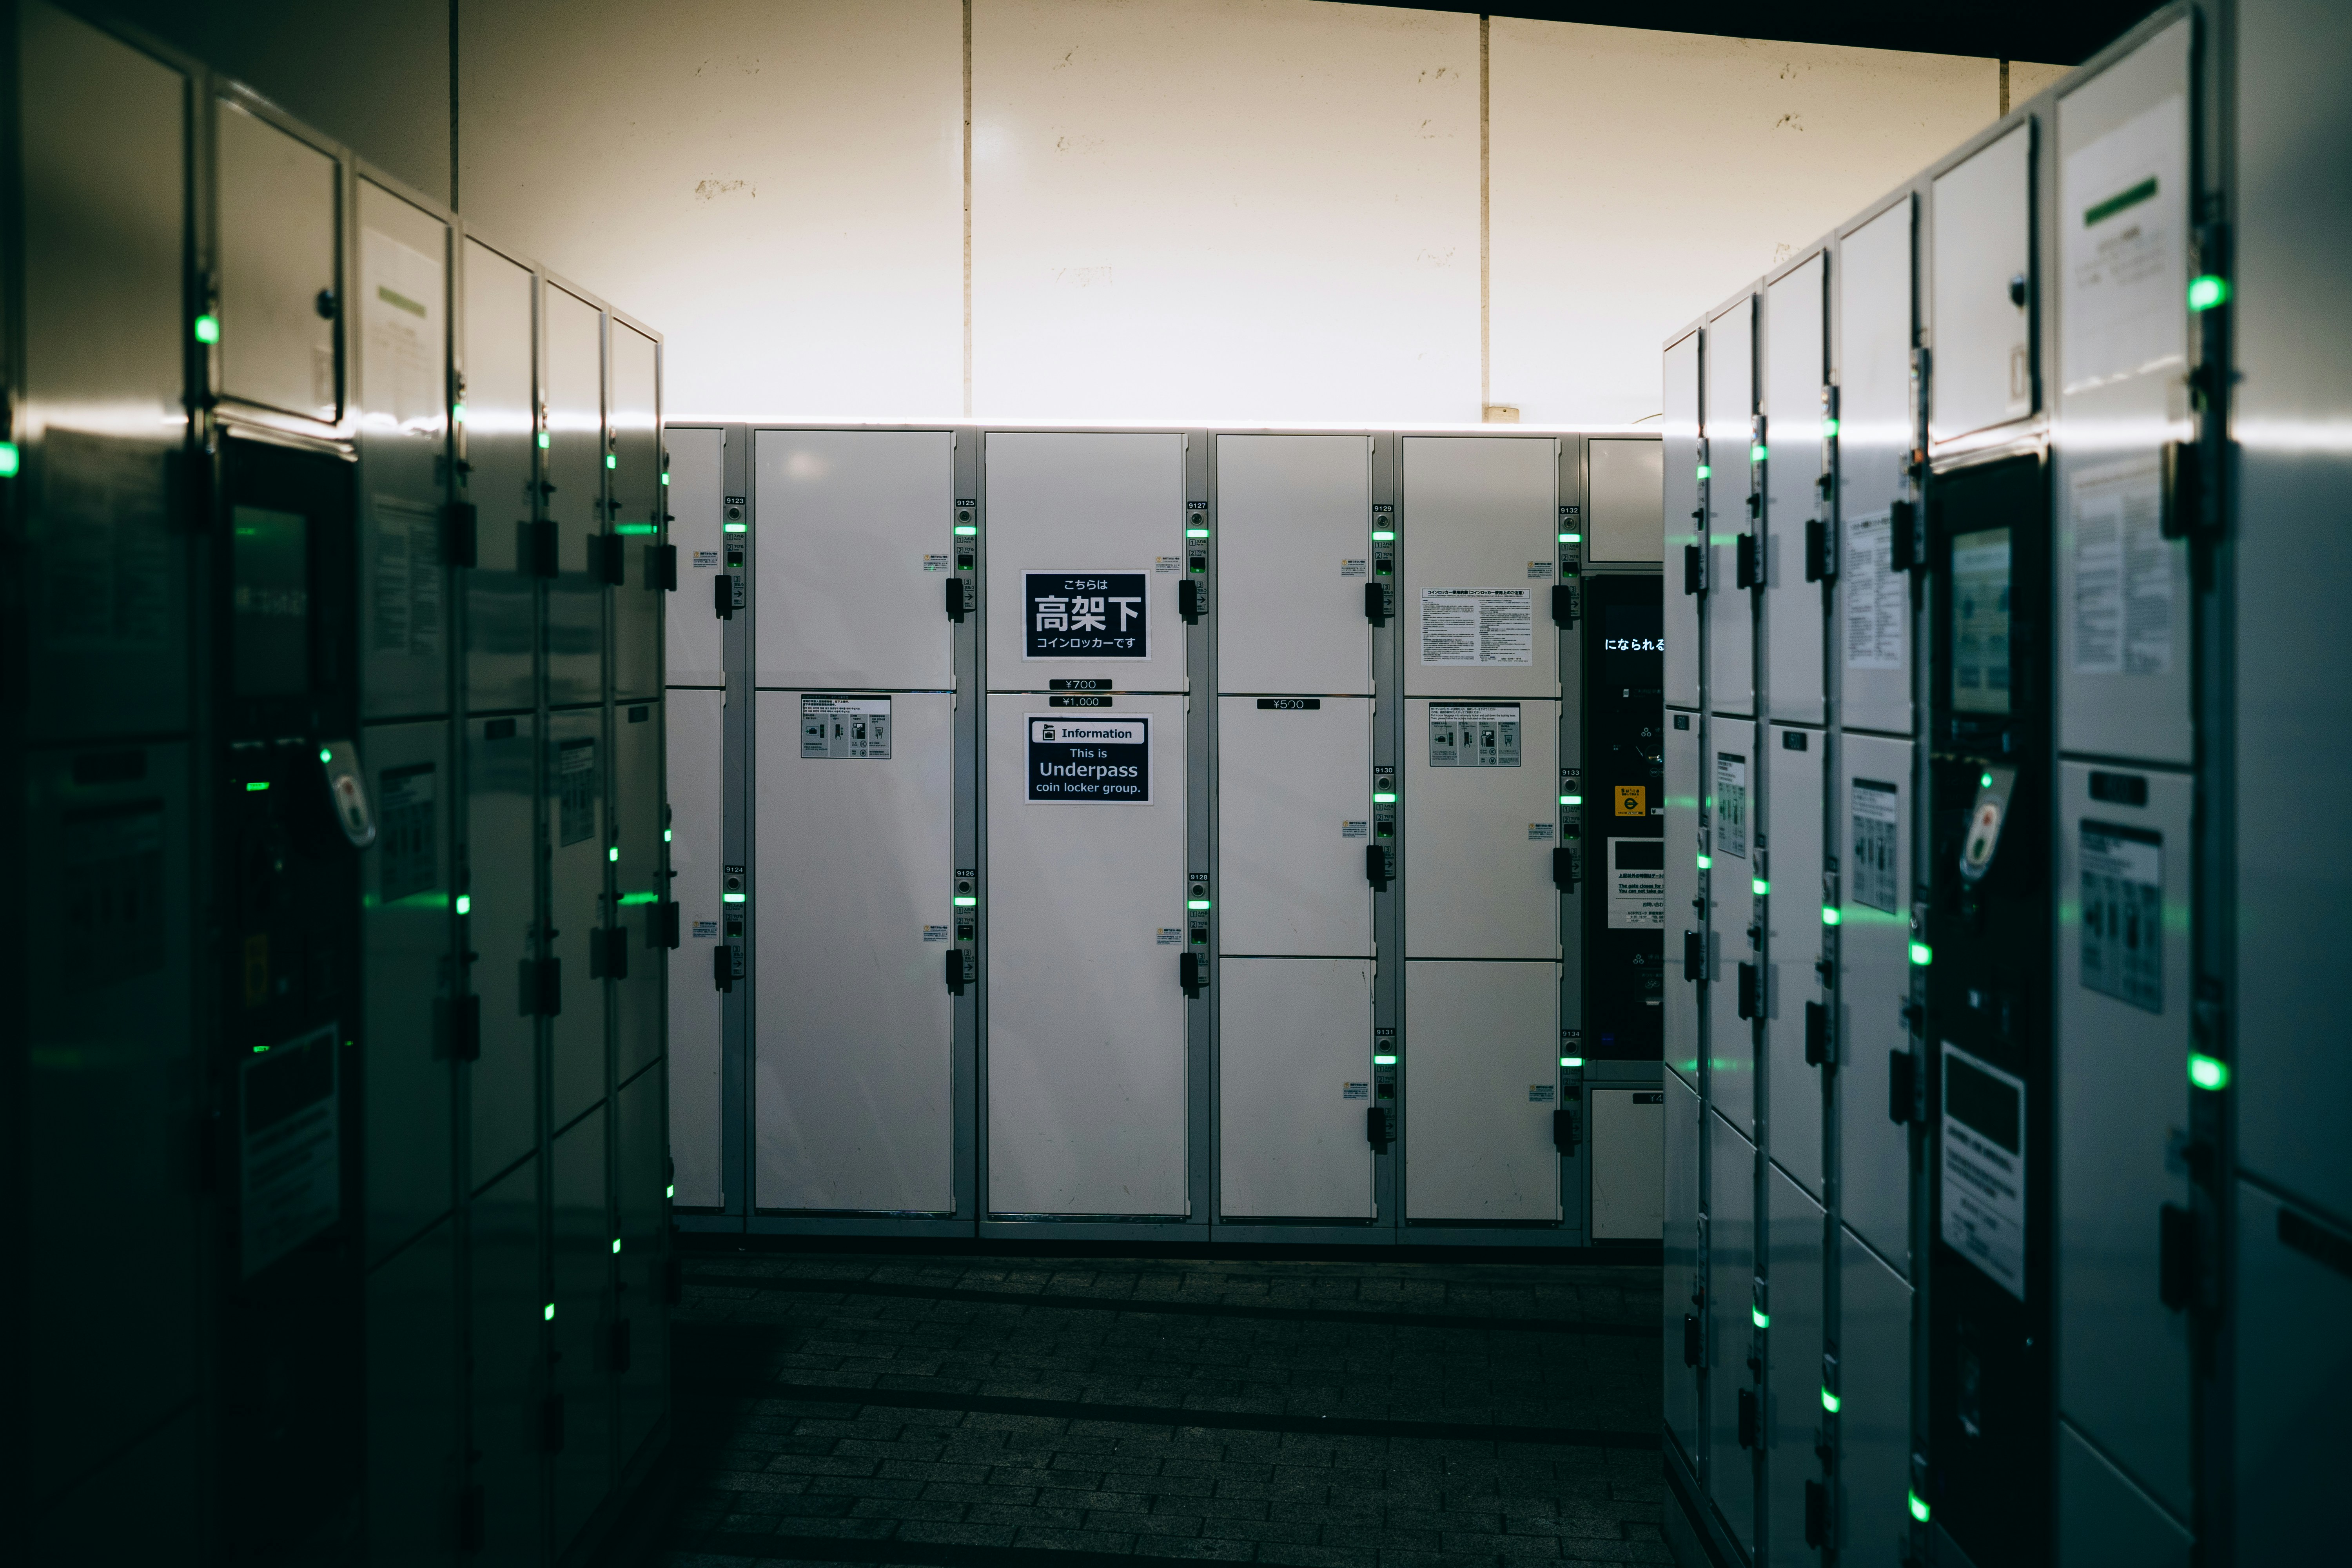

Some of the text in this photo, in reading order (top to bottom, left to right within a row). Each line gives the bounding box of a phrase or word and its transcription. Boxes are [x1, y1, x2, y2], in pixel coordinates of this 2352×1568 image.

[1065, 580, 1108, 590] こちらは
[1035, 595, 1141, 632] 高架下
[1038, 638, 1135, 648] コインロッカーです
[1066, 681, 1096, 689] ¥700
[1063, 698, 1099, 706] ¥1,000
[1273, 700, 1304, 709] ¥500
[1062, 729, 1132, 738] Information
[1070, 749, 1107, 758] This is
[1040, 762, 1138, 780] Underpass
[1036, 783, 1141, 794] coin locker group.
